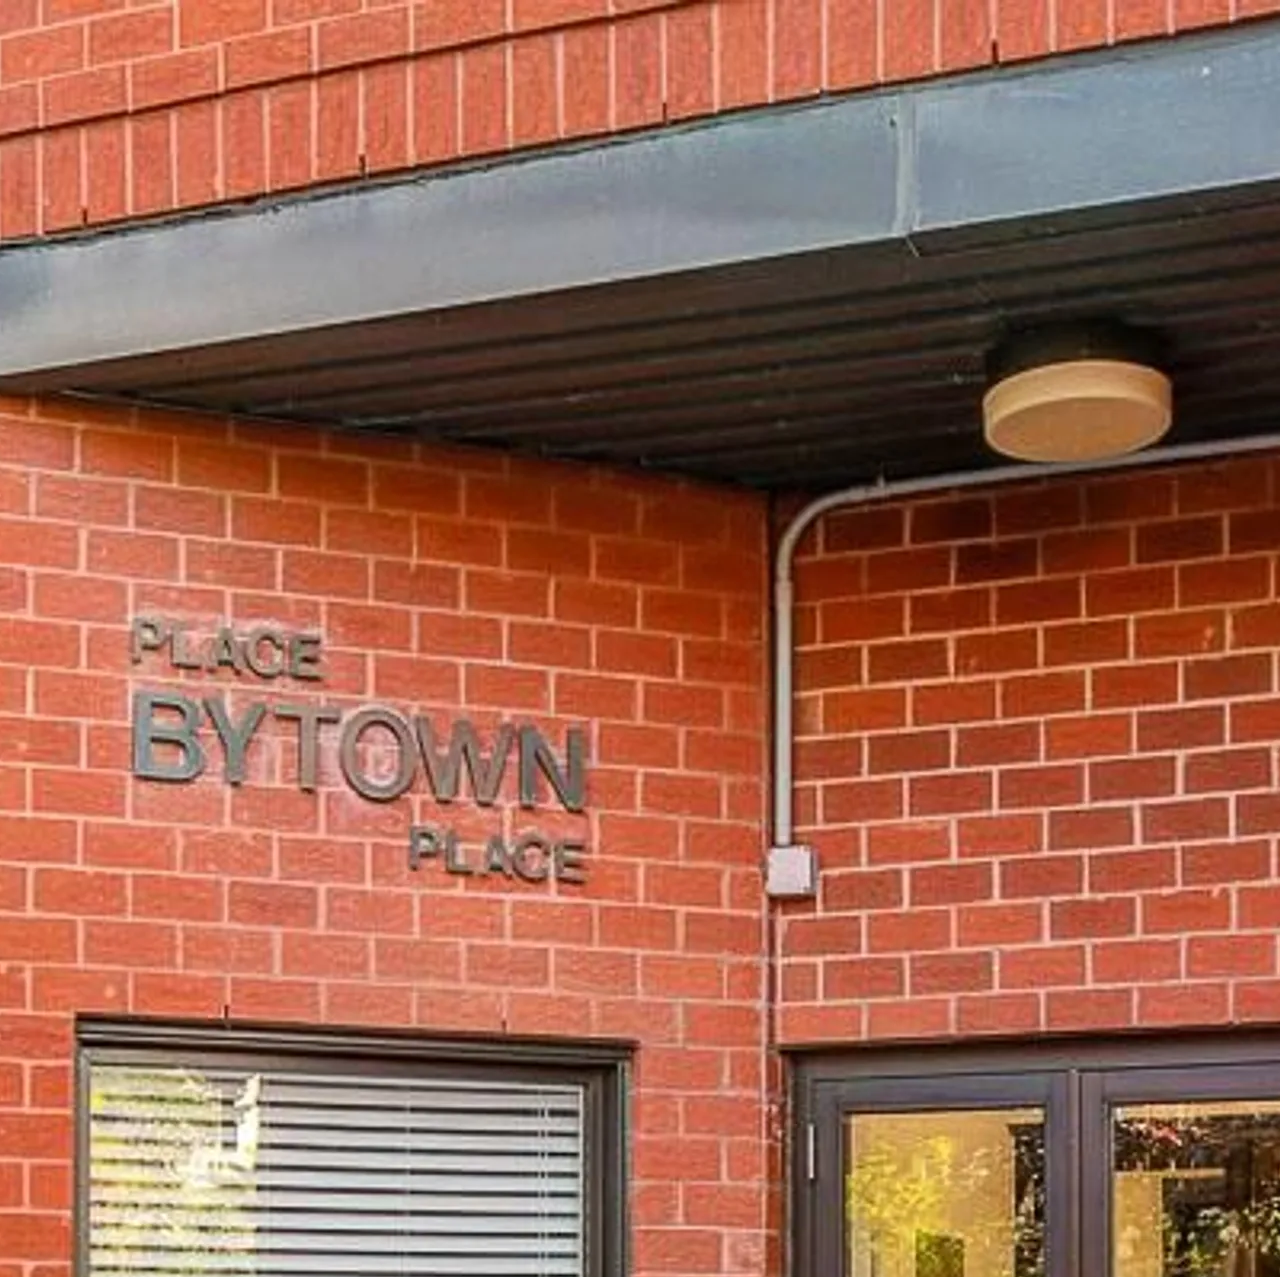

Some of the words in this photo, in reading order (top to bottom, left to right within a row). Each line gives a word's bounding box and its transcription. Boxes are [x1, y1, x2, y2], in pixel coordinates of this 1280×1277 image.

[131, 615, 322, 681] PLACE
[131, 691, 588, 813] BYTOWN
[408, 823, 588, 884] PLACE
